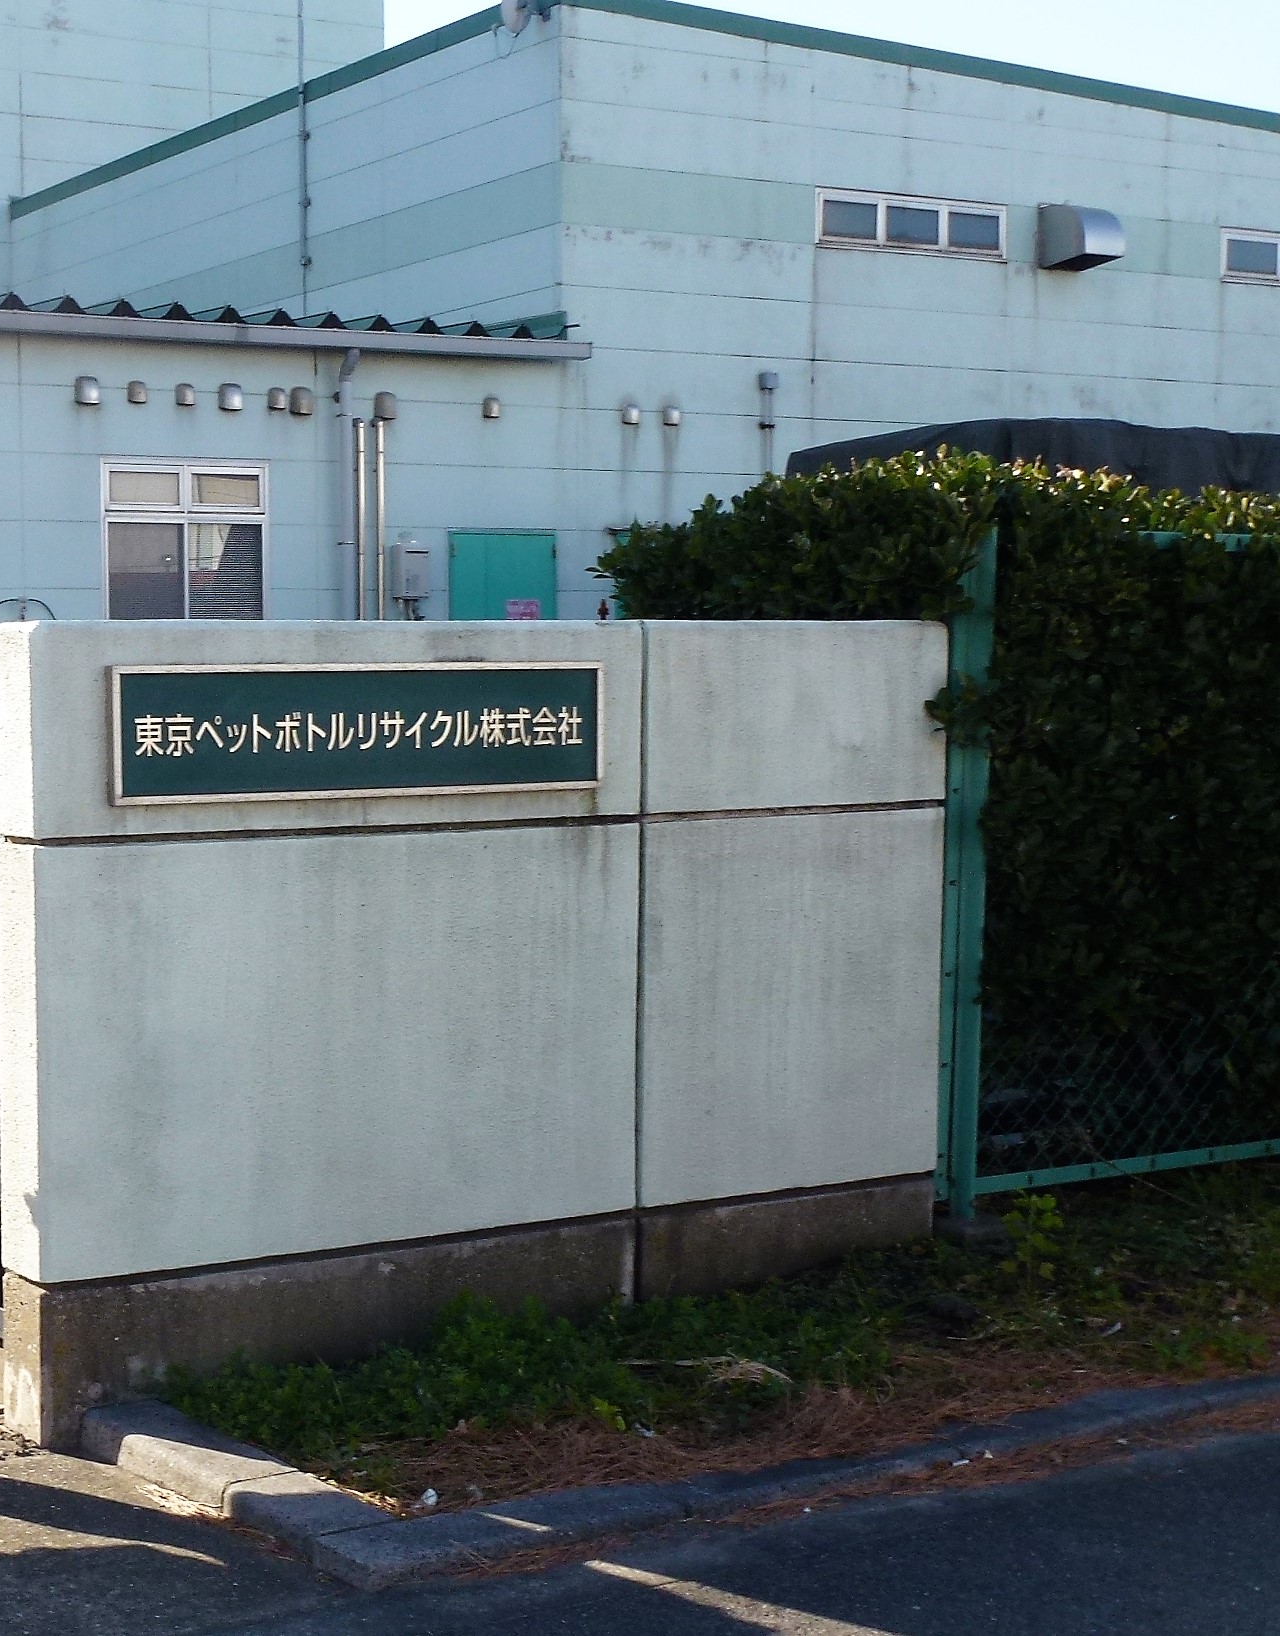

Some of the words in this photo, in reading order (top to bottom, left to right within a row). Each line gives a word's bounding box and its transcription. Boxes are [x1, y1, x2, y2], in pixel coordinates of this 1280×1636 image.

[134, 706, 583, 757] 東京ペットボトルリサイクル株式会社
